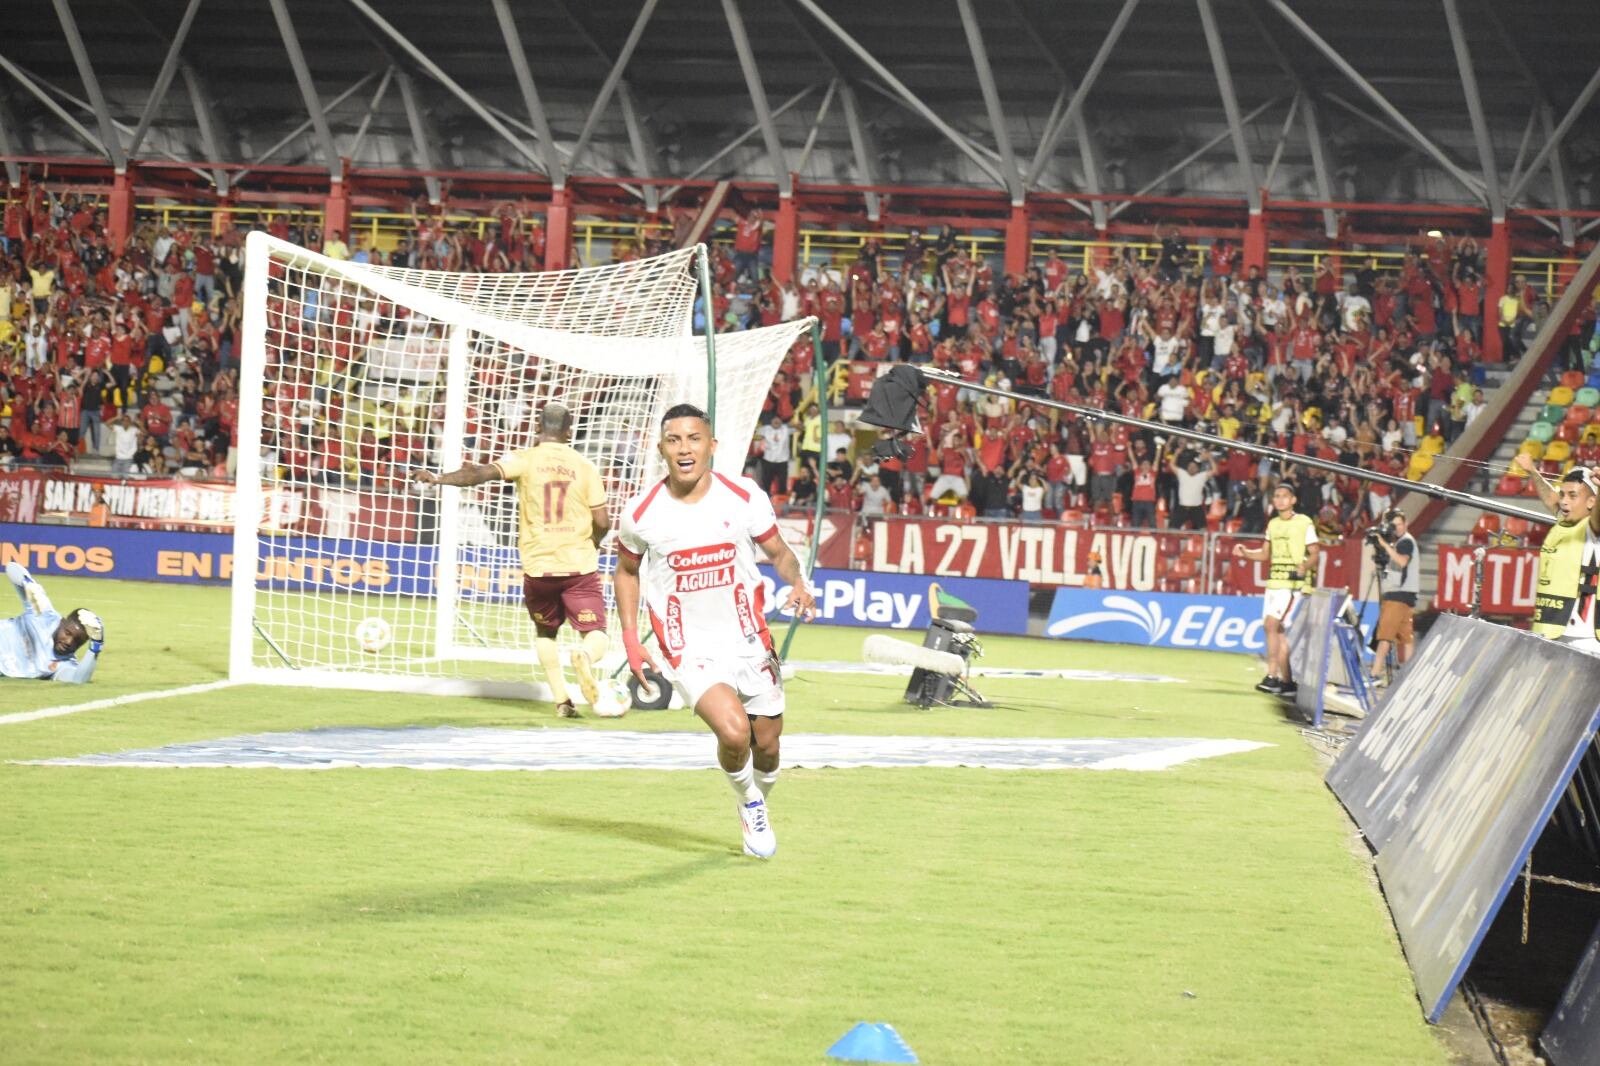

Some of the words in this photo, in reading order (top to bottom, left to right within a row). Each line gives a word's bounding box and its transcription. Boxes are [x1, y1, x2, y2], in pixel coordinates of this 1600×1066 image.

[544, 480, 571, 524] 17
[0, 542, 115, 573] NTOS
[157, 550, 212, 578] EN
[669, 548, 736, 567] Colanta
[873, 521, 925, 575] LA
[935, 524, 988, 578] 27
[998, 525, 1158, 592] VILLAVO
[679, 568, 732, 591] AGUILA
[667, 600, 684, 648] BetPlay
[1170, 604, 1265, 649] Elec
